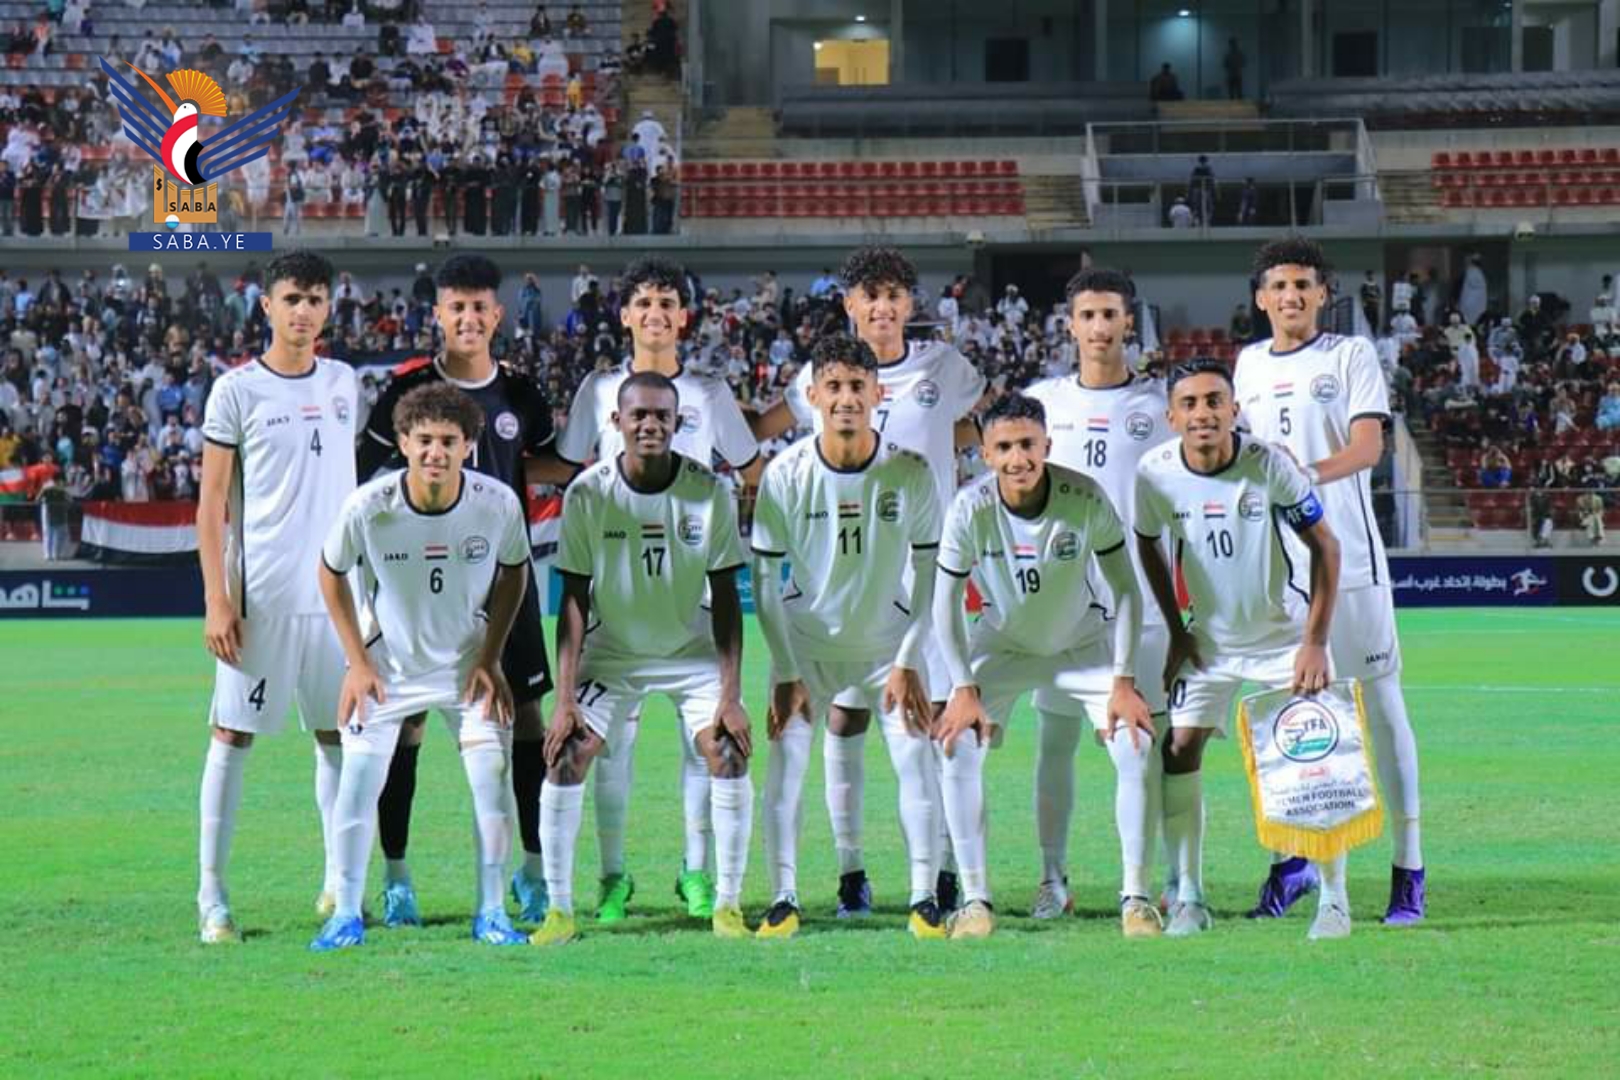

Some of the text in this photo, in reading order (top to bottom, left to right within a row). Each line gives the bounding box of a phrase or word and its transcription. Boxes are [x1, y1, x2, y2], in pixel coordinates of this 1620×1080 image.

[877, 409, 890, 433] 7
[1280, 407, 1292, 435] 5
[310, 428, 323, 457] 4
[1083, 439, 1107, 468] 18
[838, 526, 861, 554] 11
[1206, 529, 1234, 558] 10
[642, 546, 666, 577] 17
[430, 567, 443, 594] 6
[1015, 568, 1040, 594] 19
[249, 678, 266, 710] 4
[577, 679, 608, 707] 17
